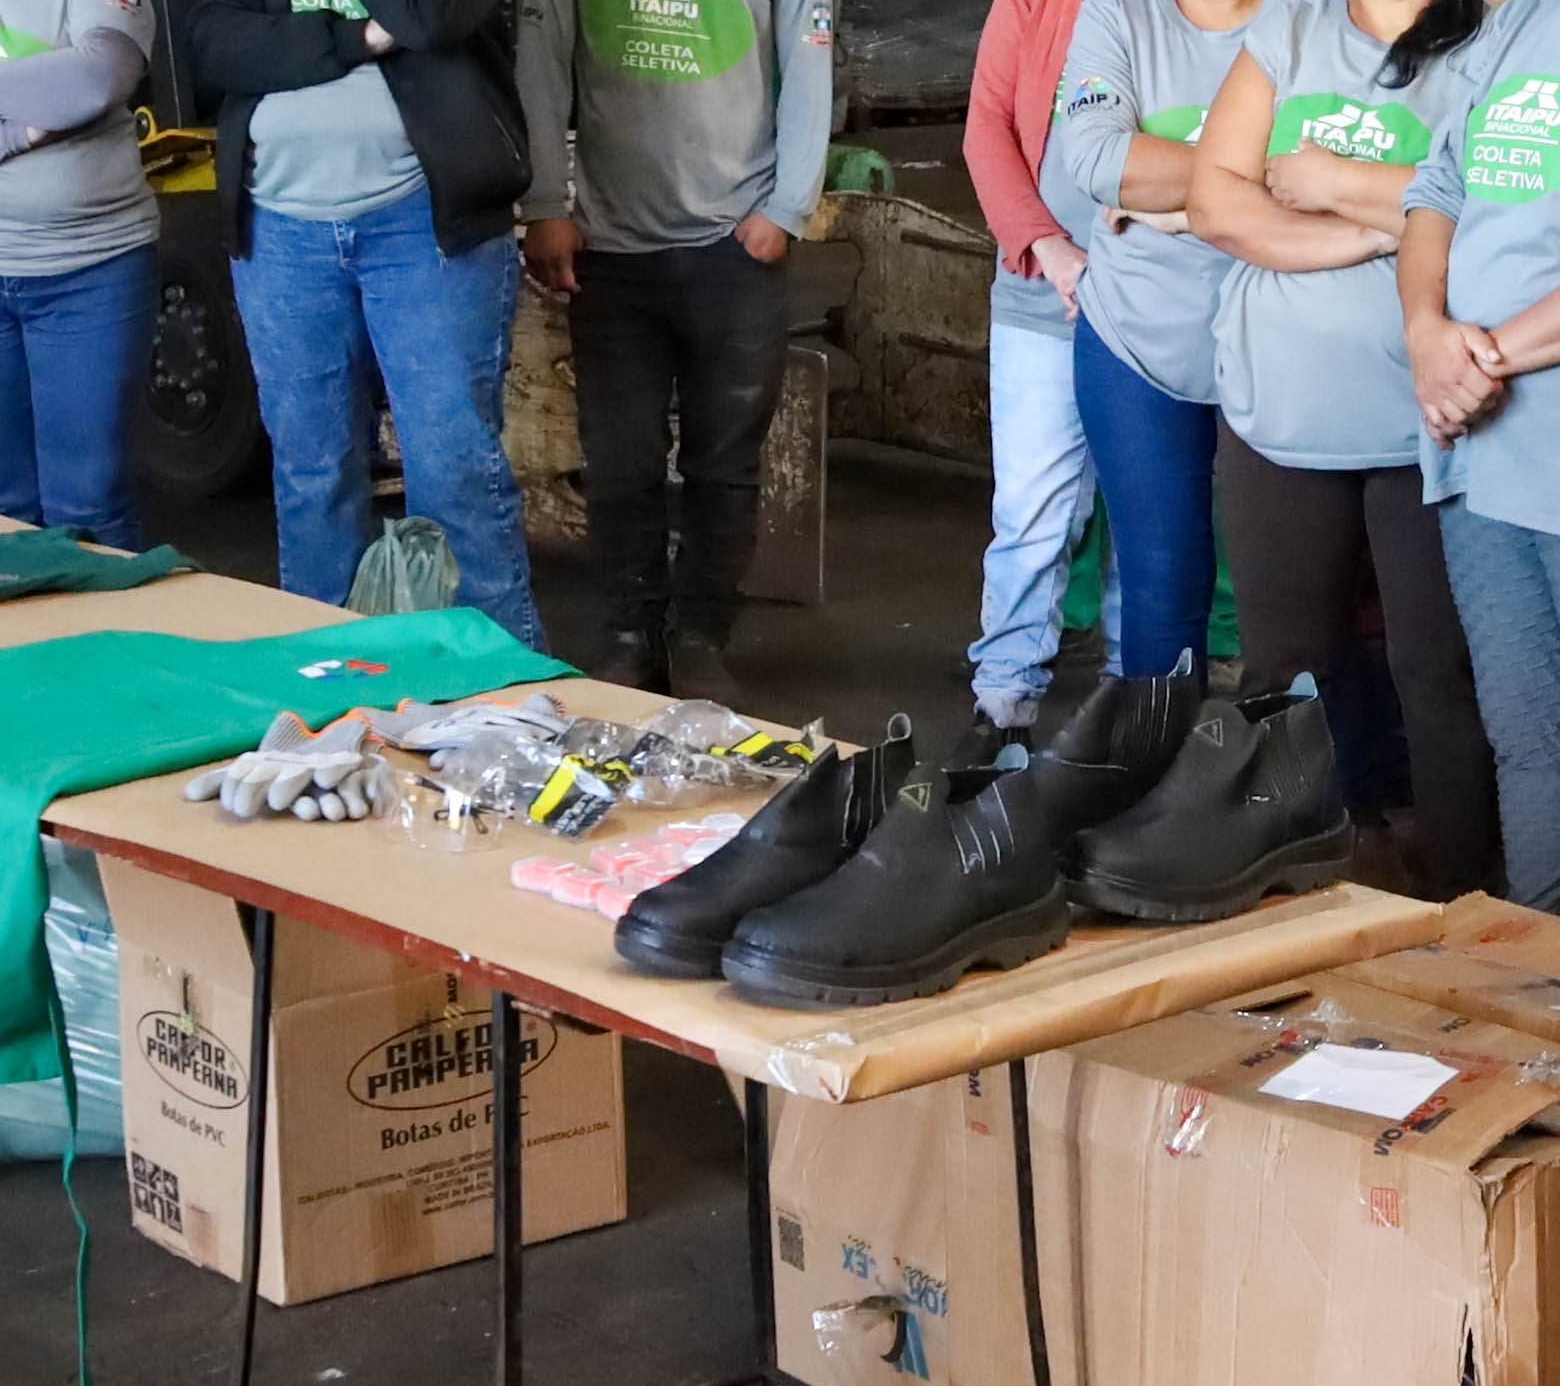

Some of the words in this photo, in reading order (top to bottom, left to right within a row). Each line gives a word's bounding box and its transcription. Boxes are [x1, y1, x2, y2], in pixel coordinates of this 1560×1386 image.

[625, 39, 695, 61] COLETA
[621, 53, 701, 76] SELETIVA
[1472, 144, 1543, 167] COLETA
[1466, 166, 1545, 192] SELETIVA
[159, 1100, 188, 1129] Botas
[190, 1117, 203, 1135] de
[203, 1123, 227, 1148] PVC
[380, 1121, 443, 1151] Botas
[449, 1108, 478, 1134] de
